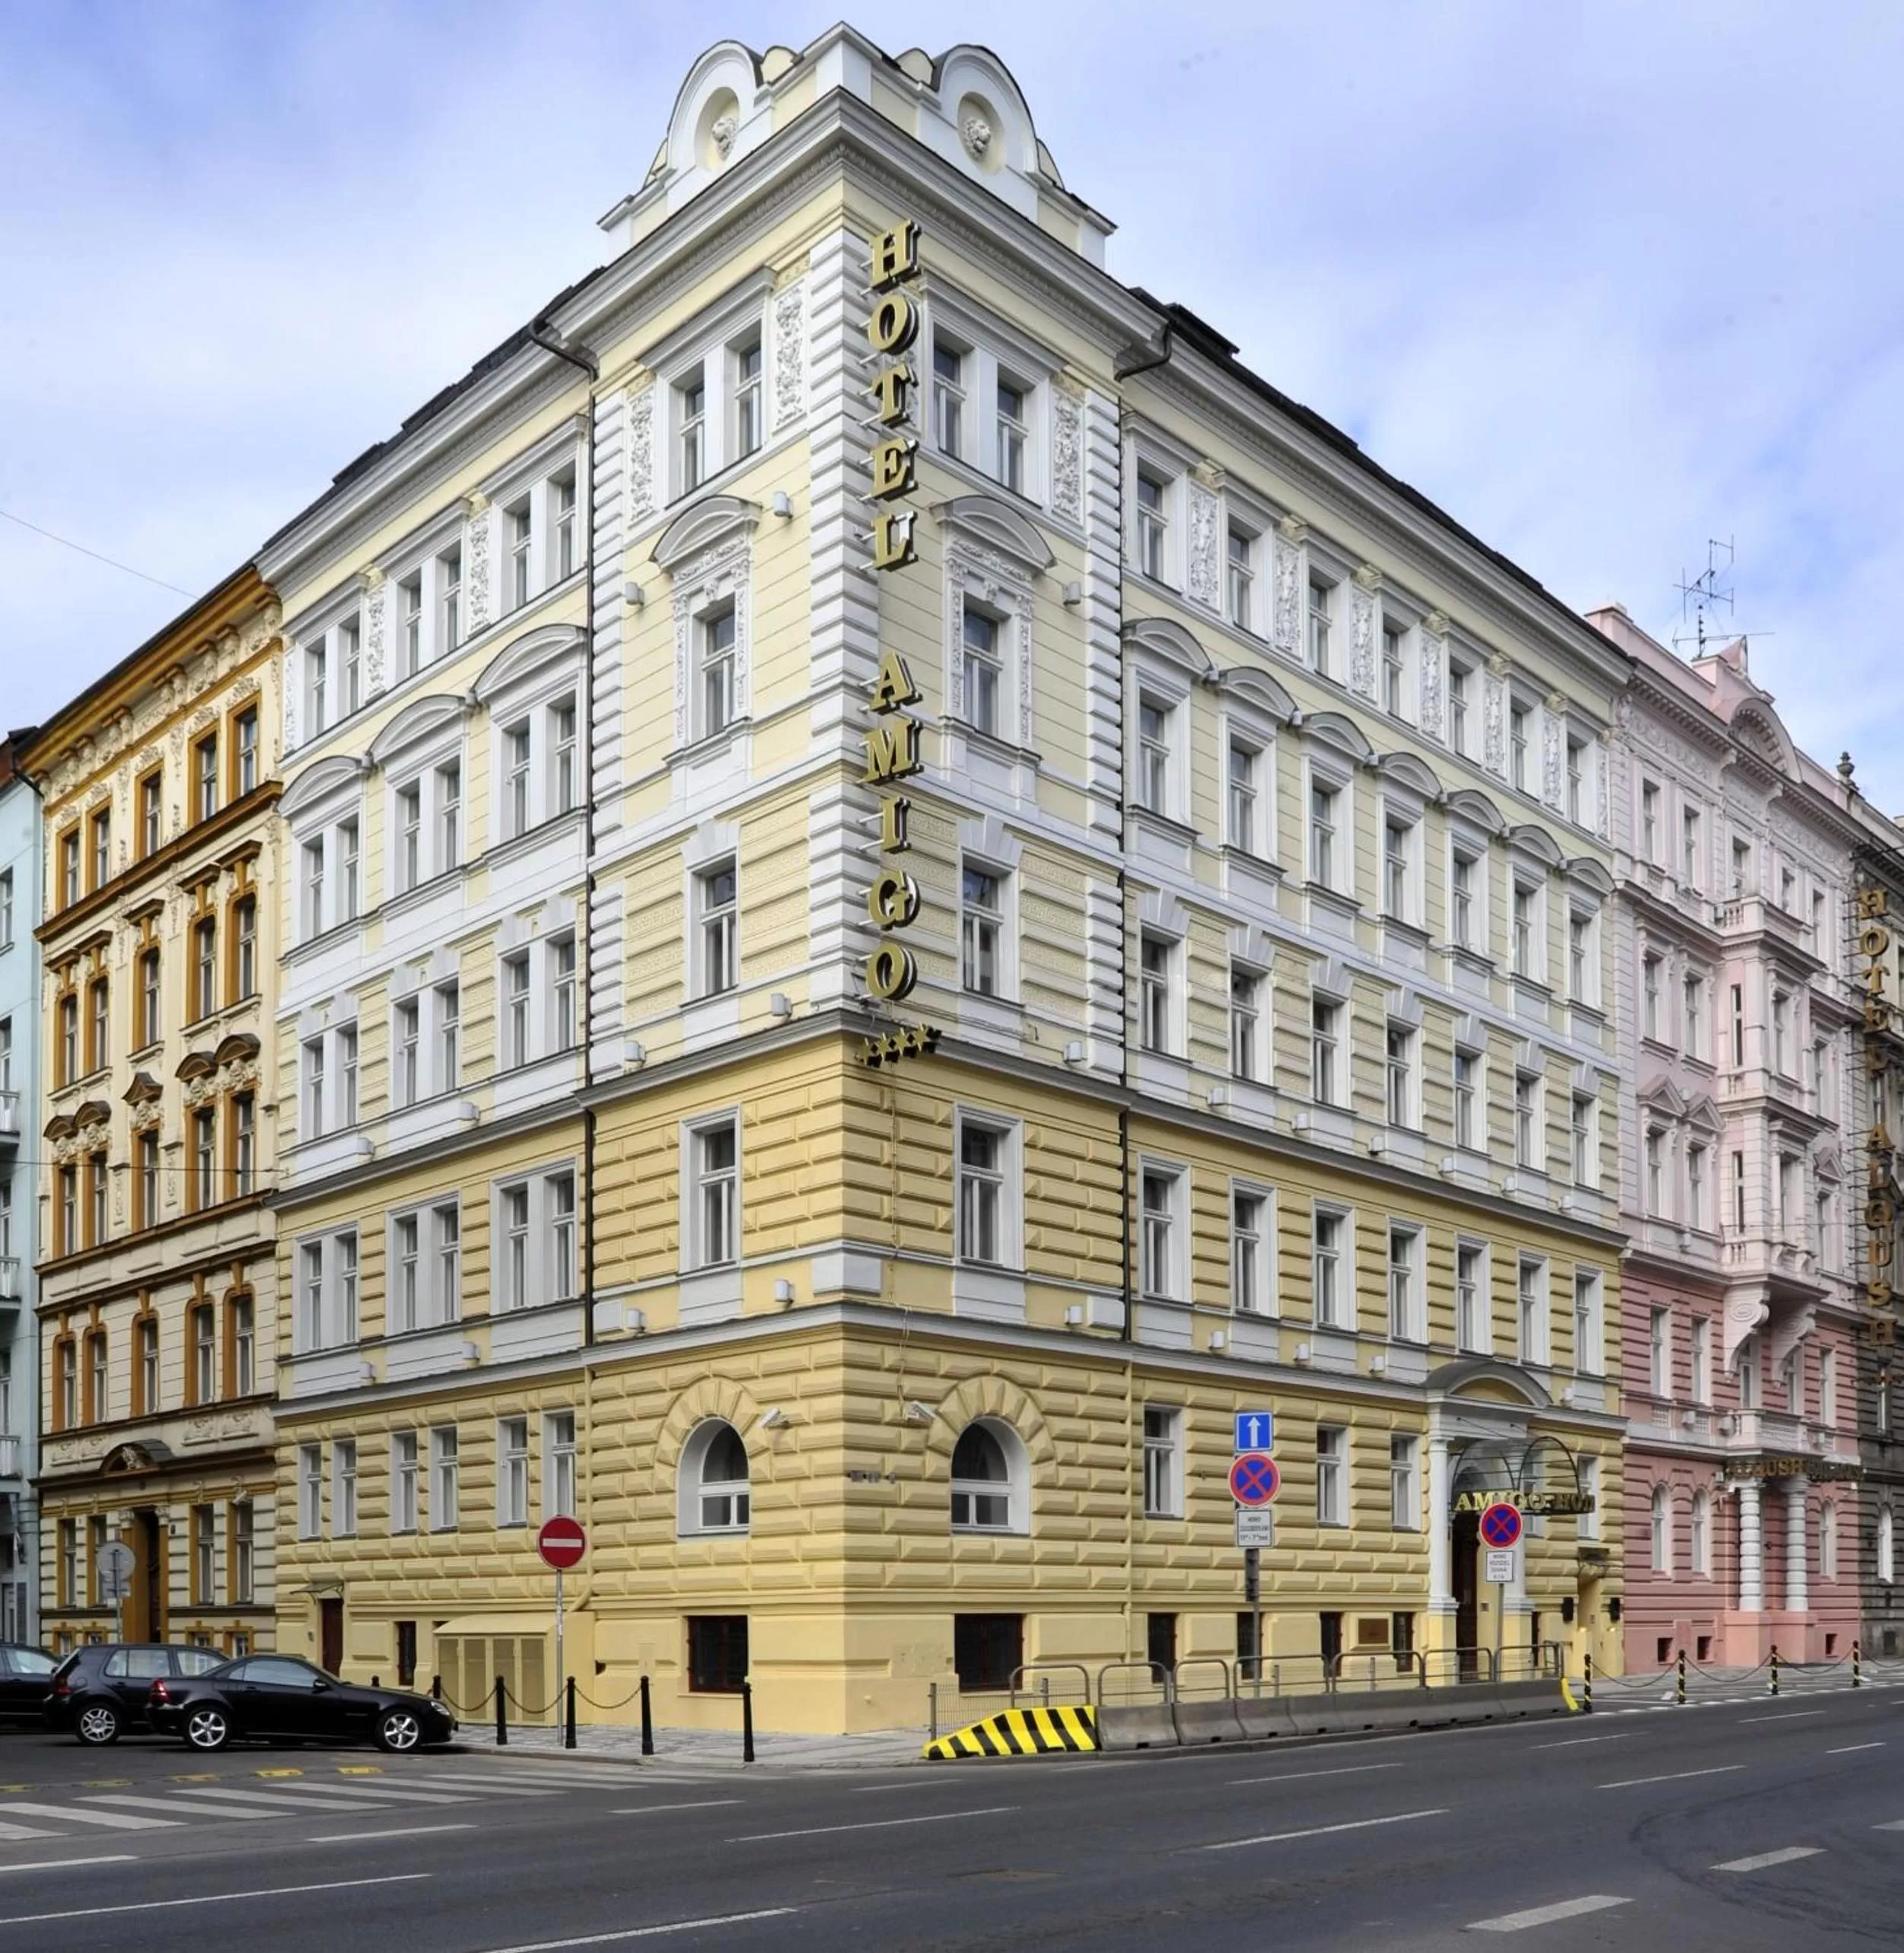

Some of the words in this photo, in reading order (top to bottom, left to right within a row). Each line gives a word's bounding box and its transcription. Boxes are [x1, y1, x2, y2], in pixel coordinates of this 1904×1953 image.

[868, 219, 922, 572] HOTEL
[863, 651, 924, 1001] AMIGO
[1858, 889, 1891, 1072] HOTEL
